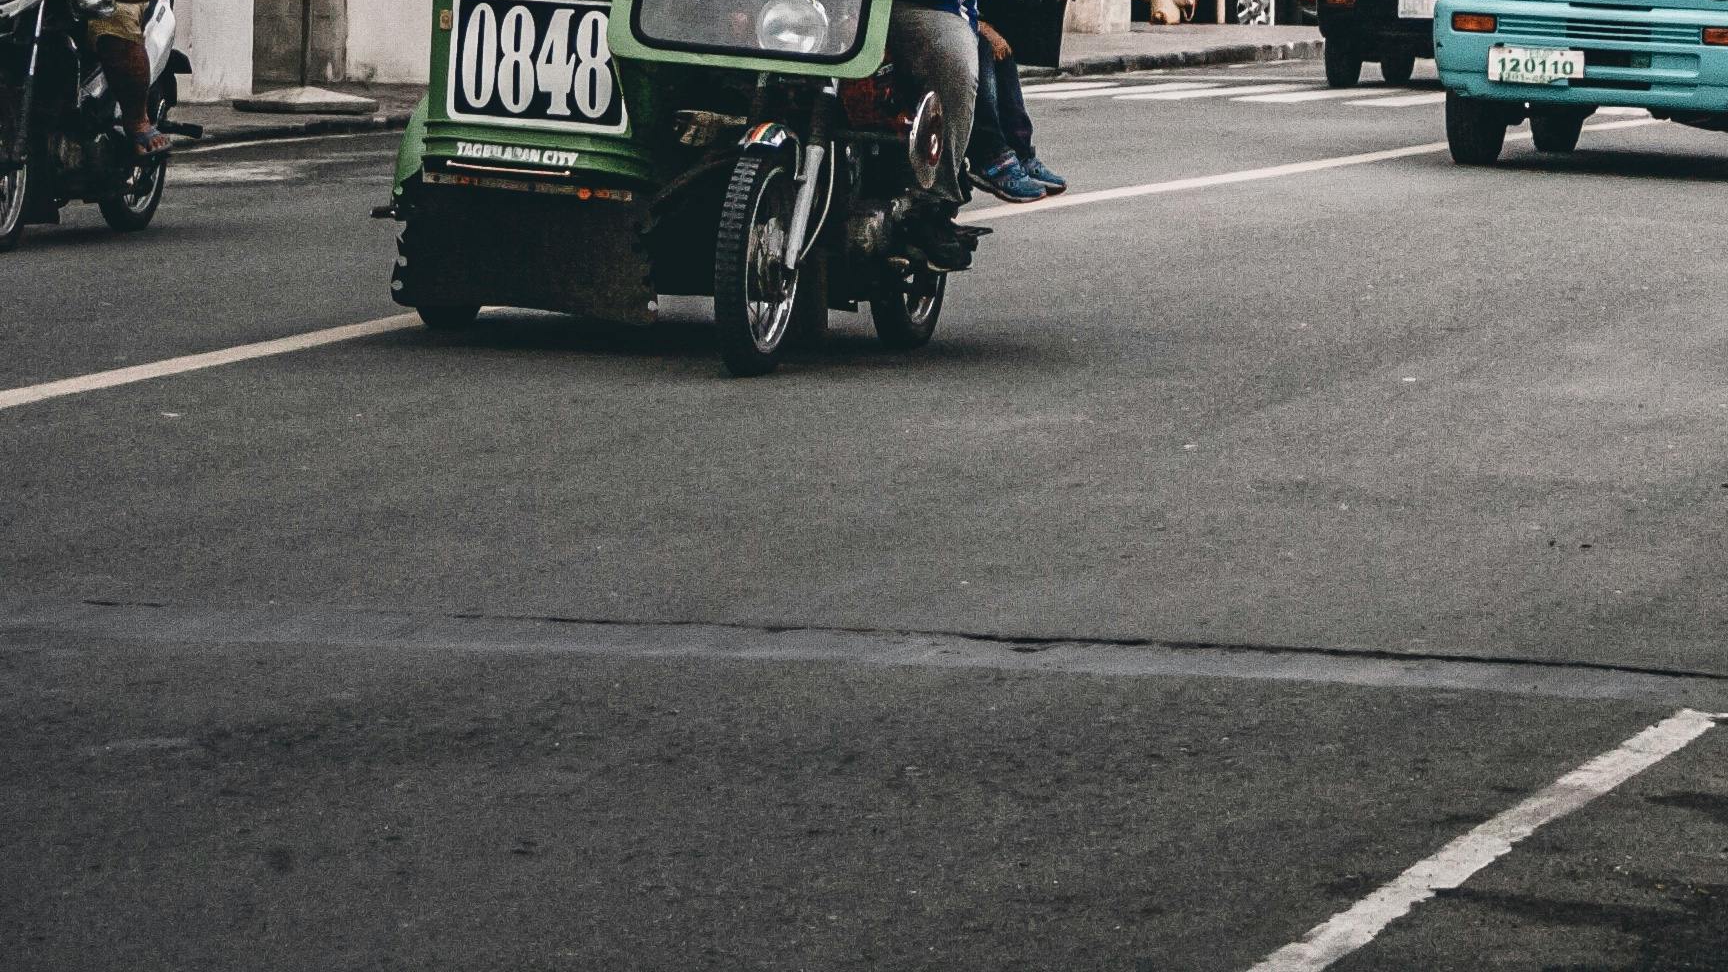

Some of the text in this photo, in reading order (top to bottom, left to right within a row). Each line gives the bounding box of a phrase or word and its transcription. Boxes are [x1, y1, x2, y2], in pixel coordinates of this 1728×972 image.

[462, 2, 613, 119] 0848
[1498, 57, 1574, 76] 120110
[542, 150, 579, 166] CITY
